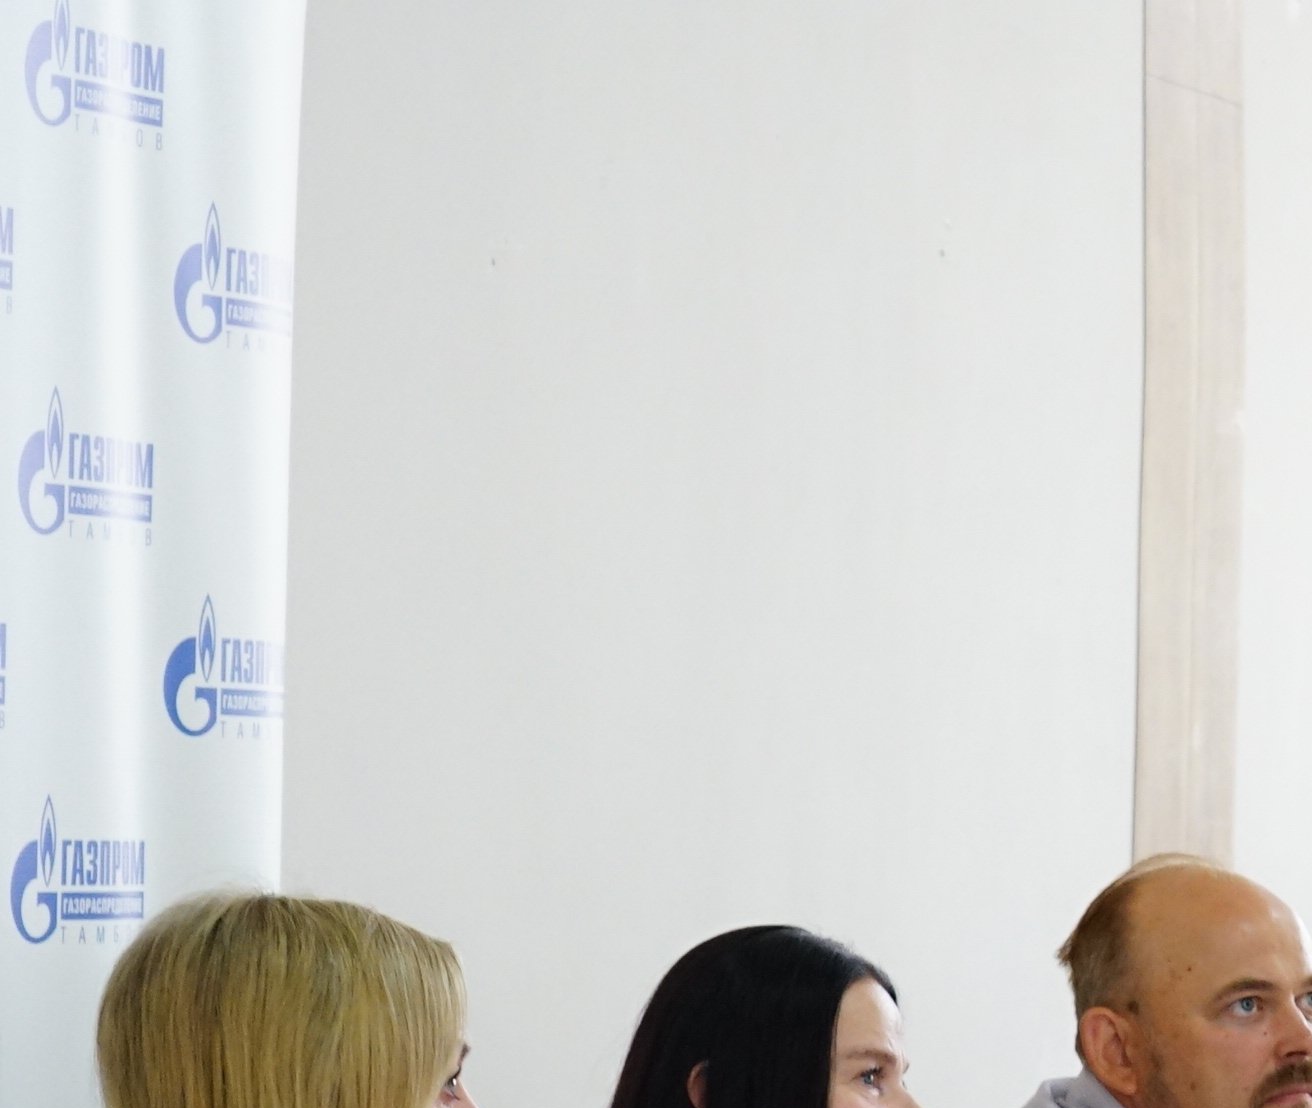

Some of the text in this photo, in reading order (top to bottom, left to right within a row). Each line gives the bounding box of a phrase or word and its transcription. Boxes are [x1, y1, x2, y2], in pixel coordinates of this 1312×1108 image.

[74, 26, 165, 94] ГАЗРОМ
[74, 114, 163, 150] ТАОВ
[68, 520, 152, 547] ТАМВ
[220, 638, 283, 685] ГАЗП
[61, 839, 145, 886] ГАЗПРОМ
[60, 924, 120, 945] ТАМБ
